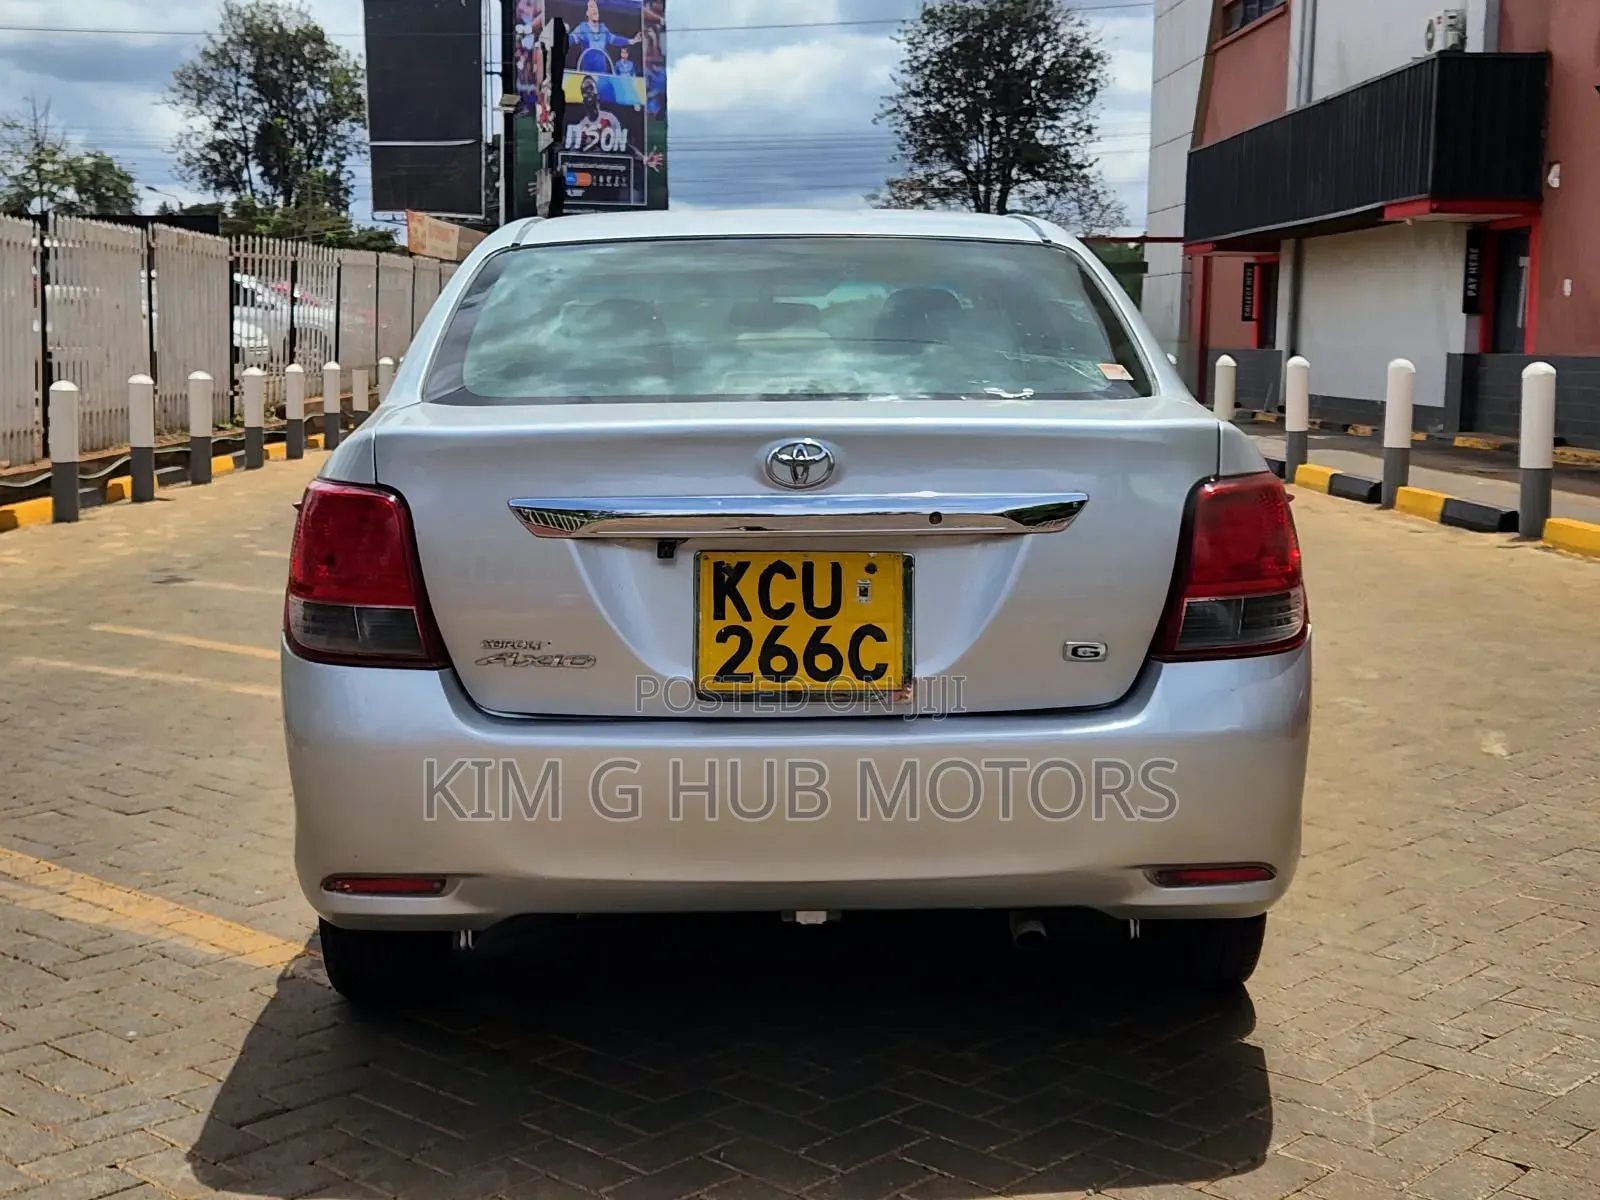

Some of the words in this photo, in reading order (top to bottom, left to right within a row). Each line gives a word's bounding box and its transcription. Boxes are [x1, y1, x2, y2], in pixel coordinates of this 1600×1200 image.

[1467, 248, 1479, 274] HERE
[1466, 278, 1478, 296] PAY
[712, 560, 842, 621] KCU
[475, 652, 596, 669] AXIO
[713, 624, 889, 683] 266C
[1071, 645, 1100, 658] G
